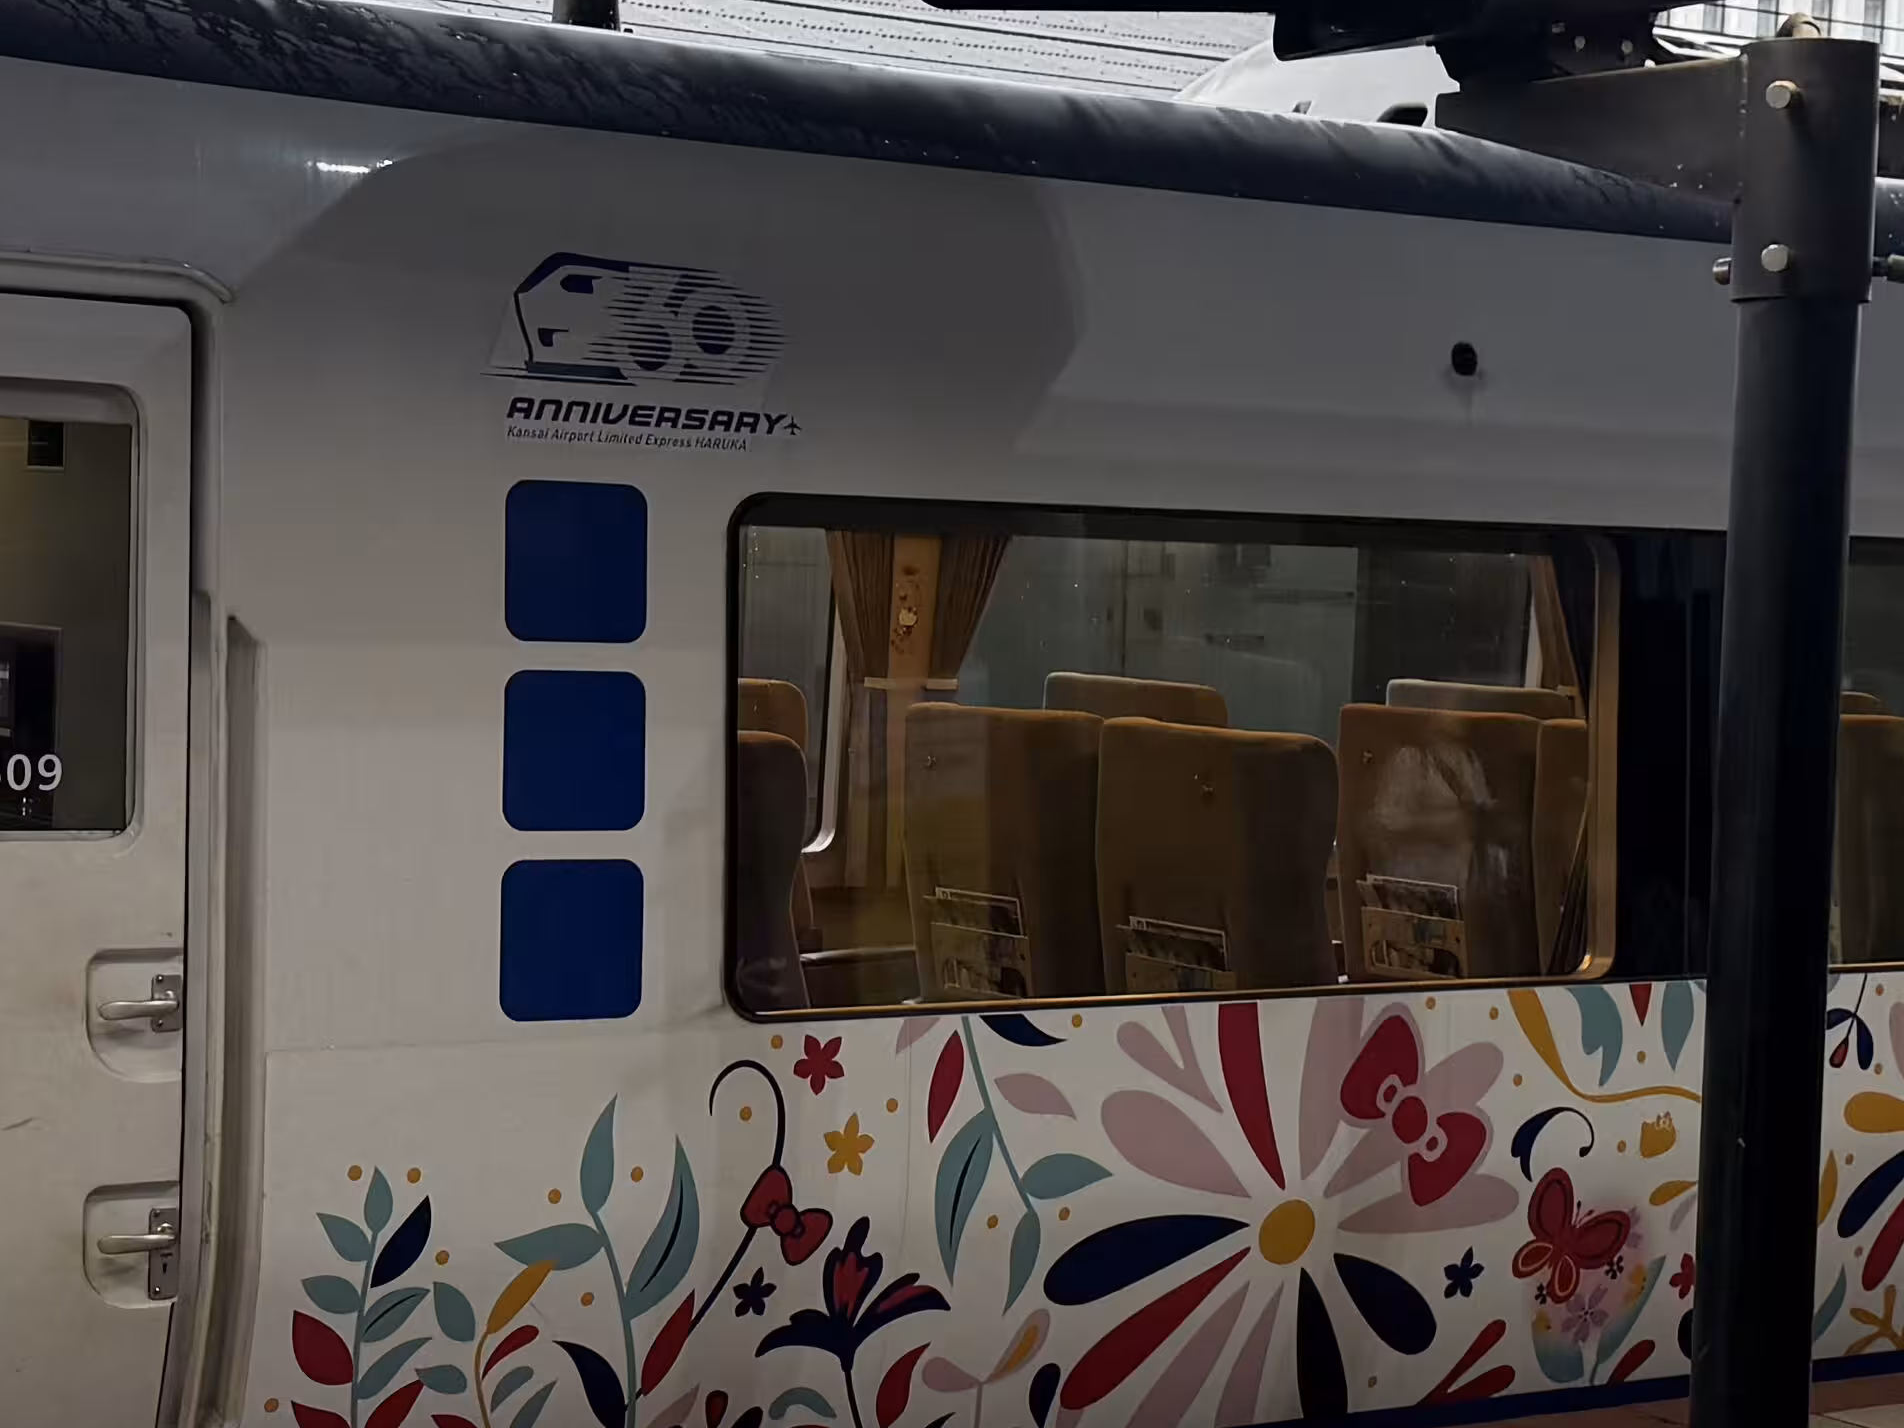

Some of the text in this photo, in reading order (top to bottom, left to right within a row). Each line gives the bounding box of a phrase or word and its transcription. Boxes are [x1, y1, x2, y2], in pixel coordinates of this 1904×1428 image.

[506, 397, 787, 435] ANNIVERSARY
[507, 425, 746, 450] Kansai Airport Limited Express HARUKA
